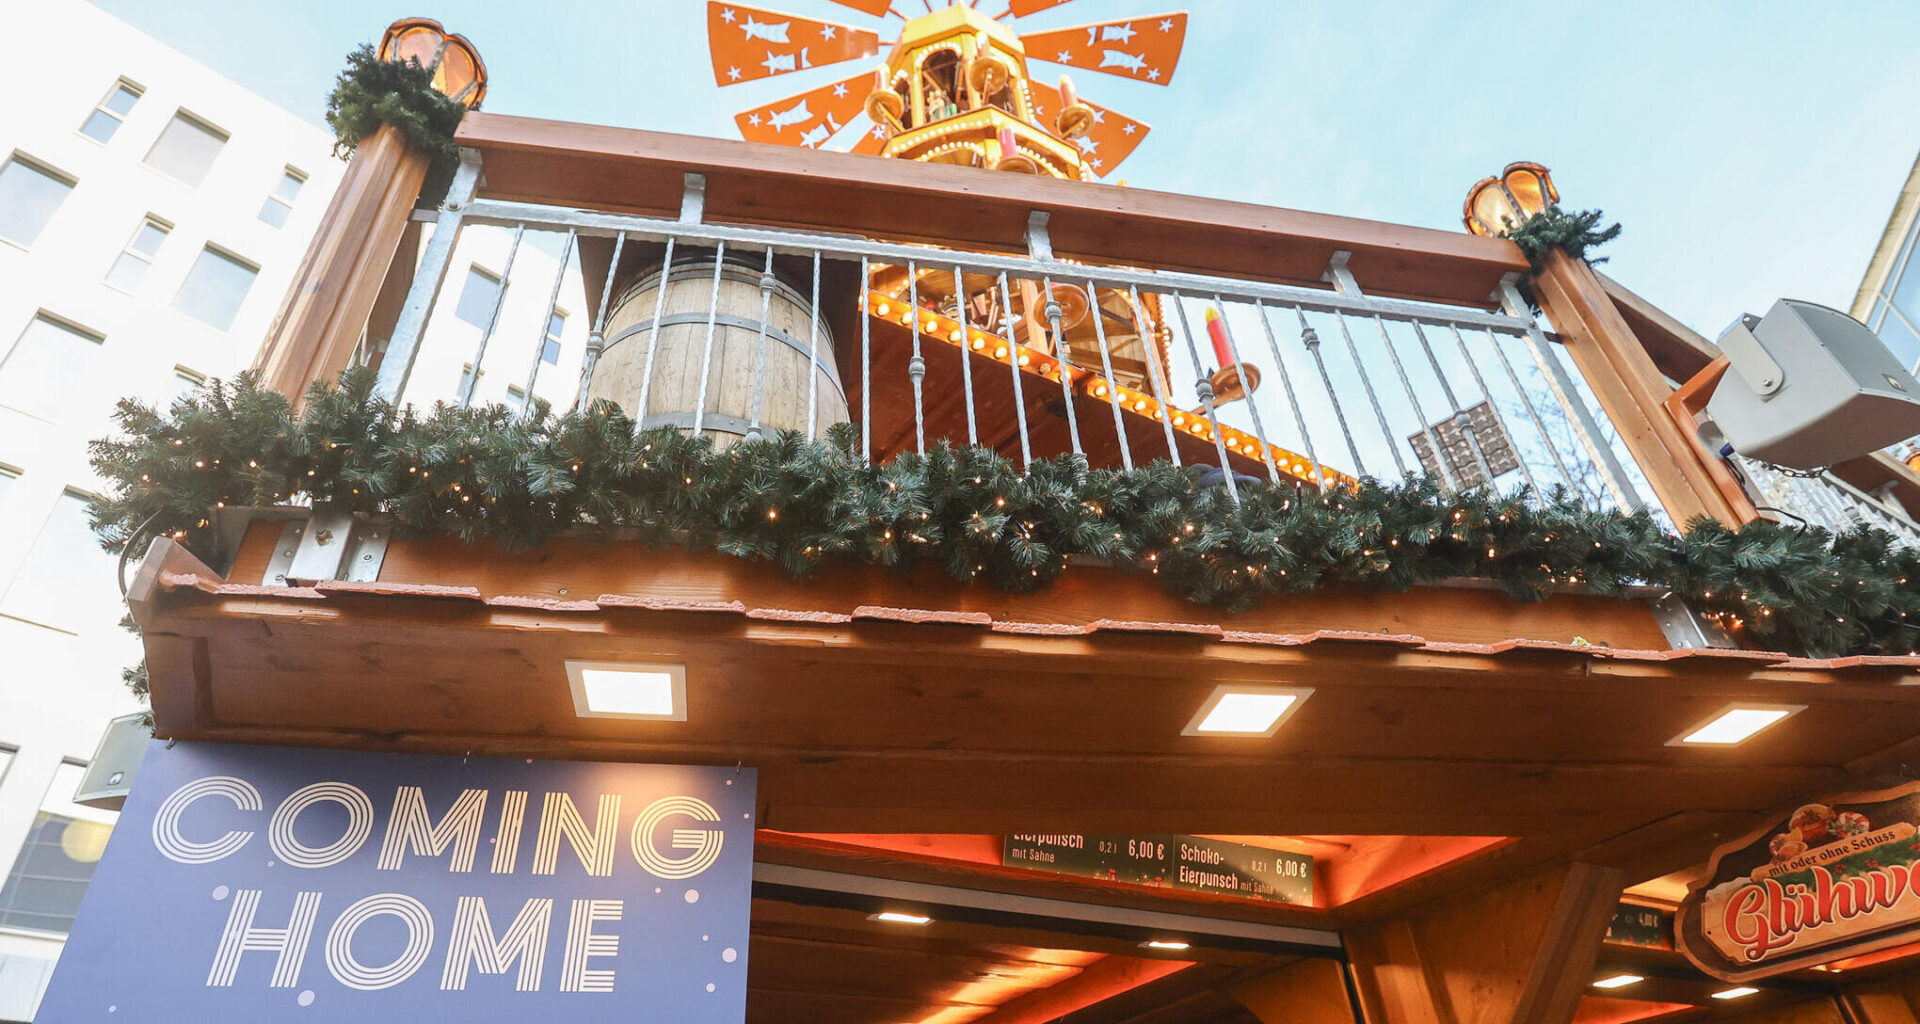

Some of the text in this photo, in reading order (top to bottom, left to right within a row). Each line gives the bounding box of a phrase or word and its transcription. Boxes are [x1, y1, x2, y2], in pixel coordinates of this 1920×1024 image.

[152, 776, 724, 880] COMING
[1012, 848, 1055, 863] mit Sahne
[1128, 839, 1154, 859] 6,00
[1156, 843, 1165, 860] €
[1180, 843, 1224, 865] Schoko-
[1276, 858, 1298, 877] 6,00
[1300, 862, 1307, 878] €
[1769, 831, 1896, 877] mit oder ohne Schuss
[1180, 866, 1239, 890] Eierpunsch
[1240, 881, 1252, 892] mit
[206, 890, 624, 992] HOME
